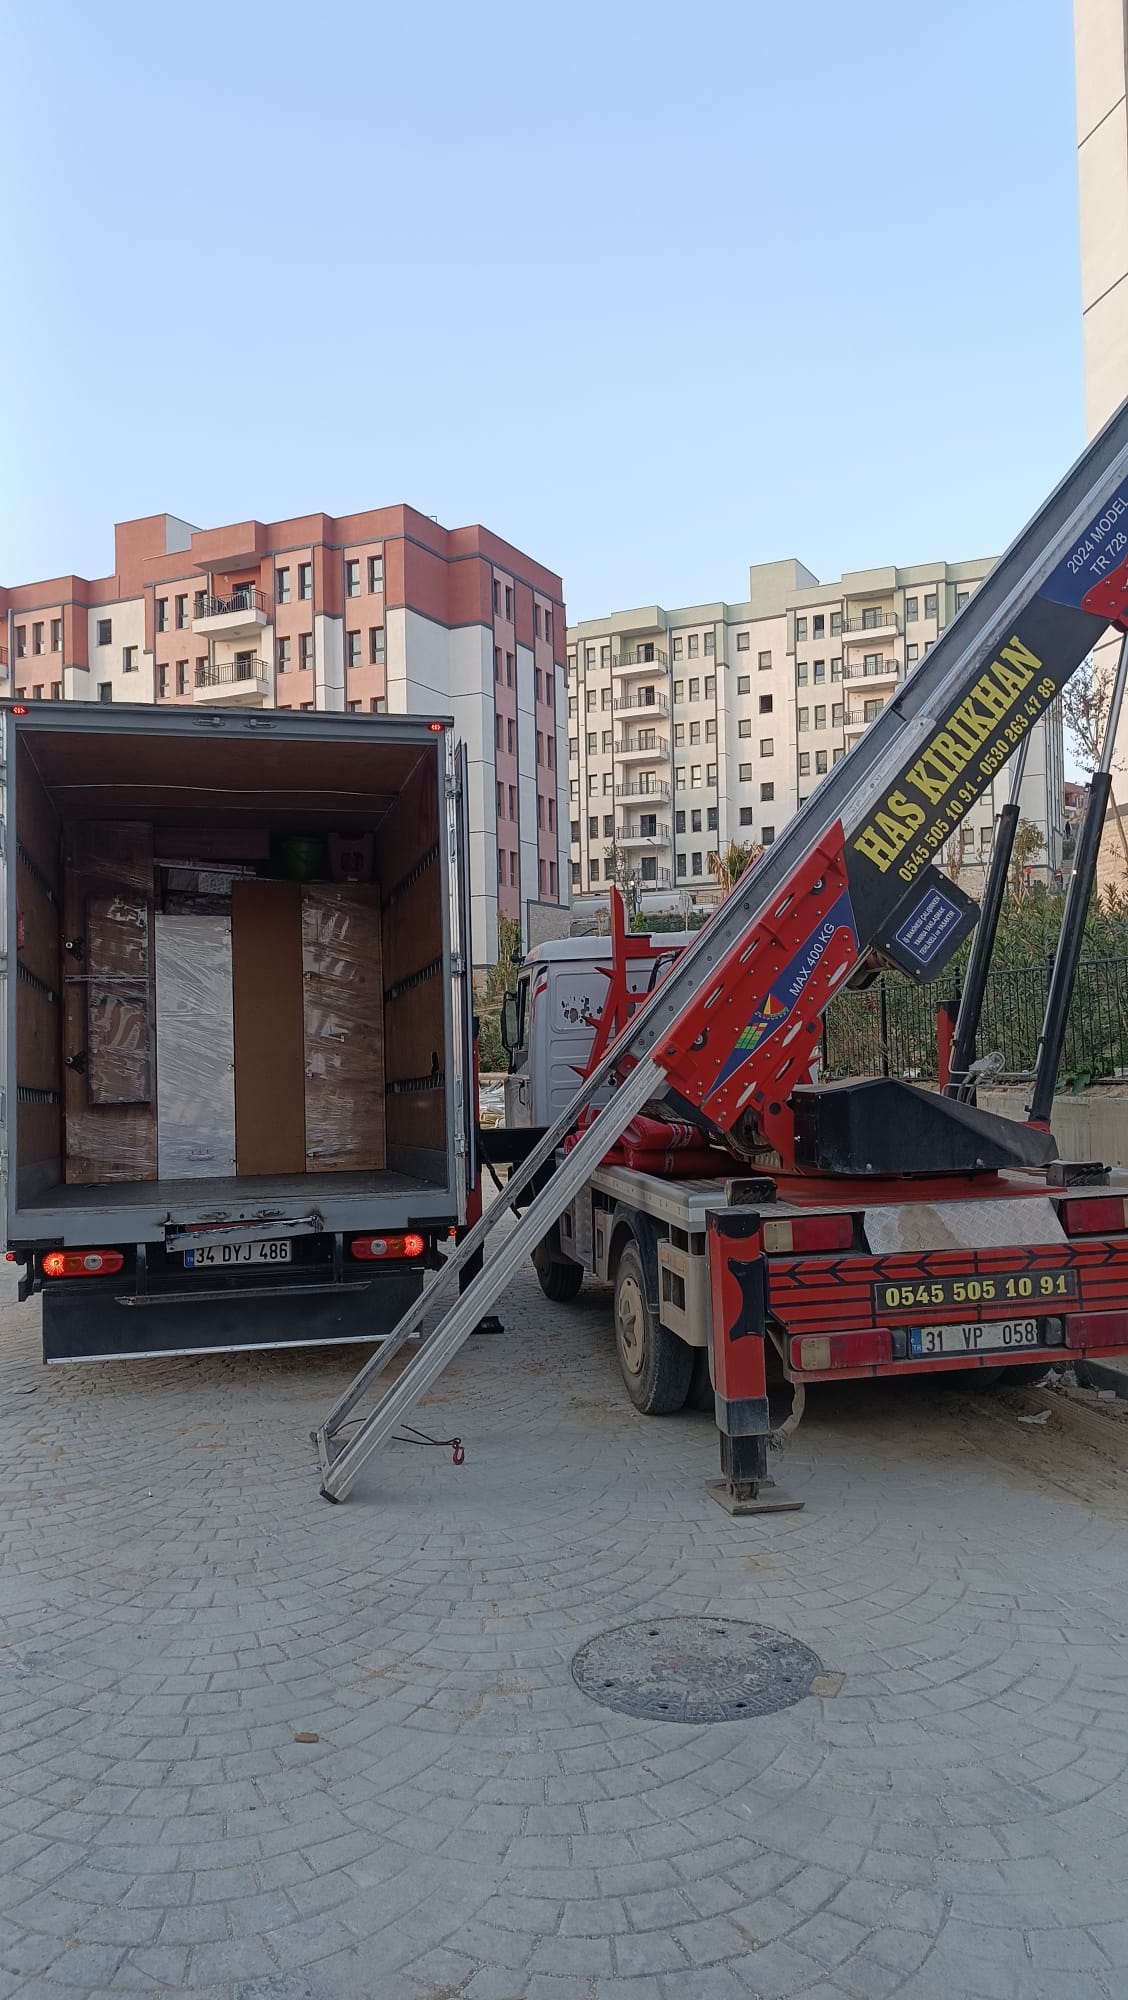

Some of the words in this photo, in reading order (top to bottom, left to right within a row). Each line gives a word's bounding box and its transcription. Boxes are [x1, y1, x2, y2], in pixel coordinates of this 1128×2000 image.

[1067, 540, 1095, 574] 2024
[1090, 497, 1128, 543] MODEL
[1089, 555, 1111, 575] TR
[1105, 532, 1128, 557] 728
[853, 790, 926, 873] HAS
[905, 635, 1043, 806] KIRIKHAN
[898, 844, 930, 882] 0545
[924, 818, 950, 847] 505
[945, 799, 964, 822] 10
[958, 781, 979, 803] 91
[979, 739, 1010, 775] 0530
[1005, 713, 1029, 744] 263
[1023, 695, 1043, 716] 47
[1037, 677, 1056, 699] 89
[789, 966, 812, 996] MAX
[807, 943, 824, 967] 400
[818, 923, 835, 943] KG
[196, 1247, 215, 1264] 34
[223, 1244, 252, 1262] DYJ
[259, 1242, 288, 1260] 486
[885, 1284, 944, 1307] 0545
[953, 1280, 996, 1301] 505
[1005, 1277, 1032, 1297] 10
[1040, 1275, 1067, 1295] 91
[926, 1330, 943, 1352] 31
[962, 1327, 983, 1349] VP
[1002, 1322, 1035, 1345] 058
